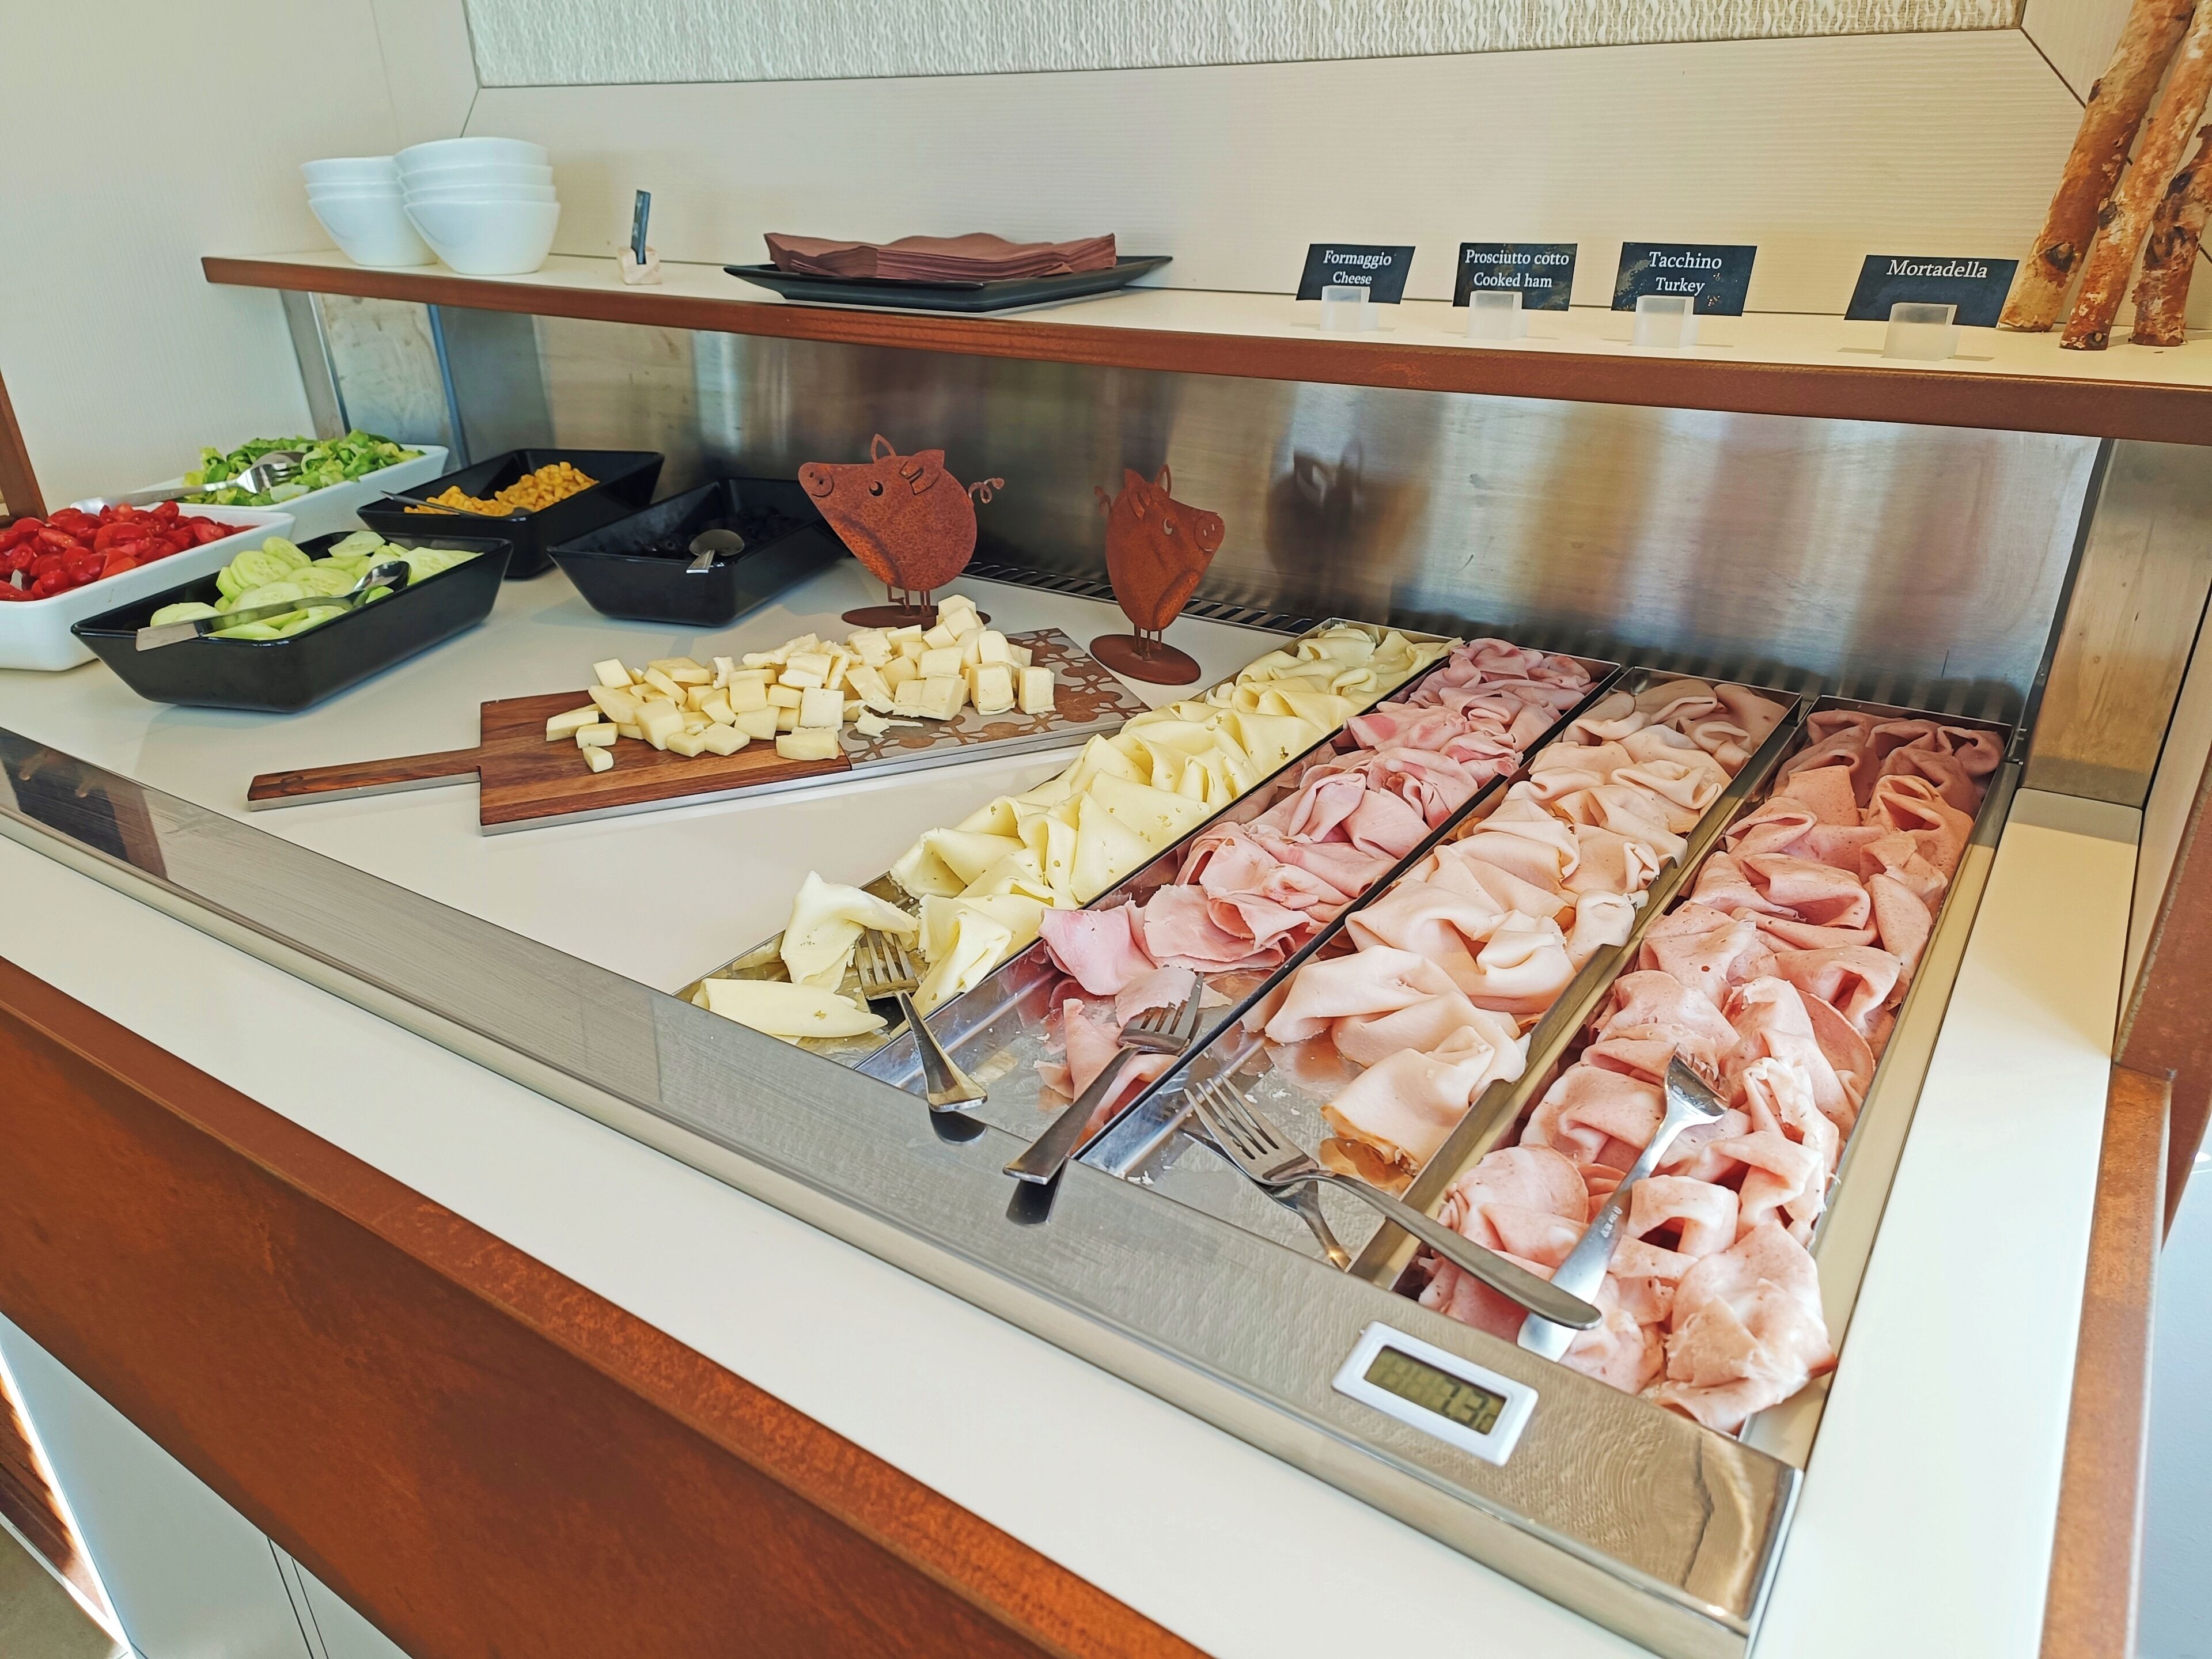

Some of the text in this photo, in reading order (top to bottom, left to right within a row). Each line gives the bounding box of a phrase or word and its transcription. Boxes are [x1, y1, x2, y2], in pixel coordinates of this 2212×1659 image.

[1322, 249, 1392, 270] Formaggio
[1464, 248, 1570, 266] Prosciutto cotto
[1648, 251, 1722, 270] Tacchino
[1332, 270, 1373, 285] Cheese
[1885, 259, 1988, 279] Mortadella
[1473, 271, 1553, 288] Cooked ham
[1655, 276, 1706, 297] Turkey
